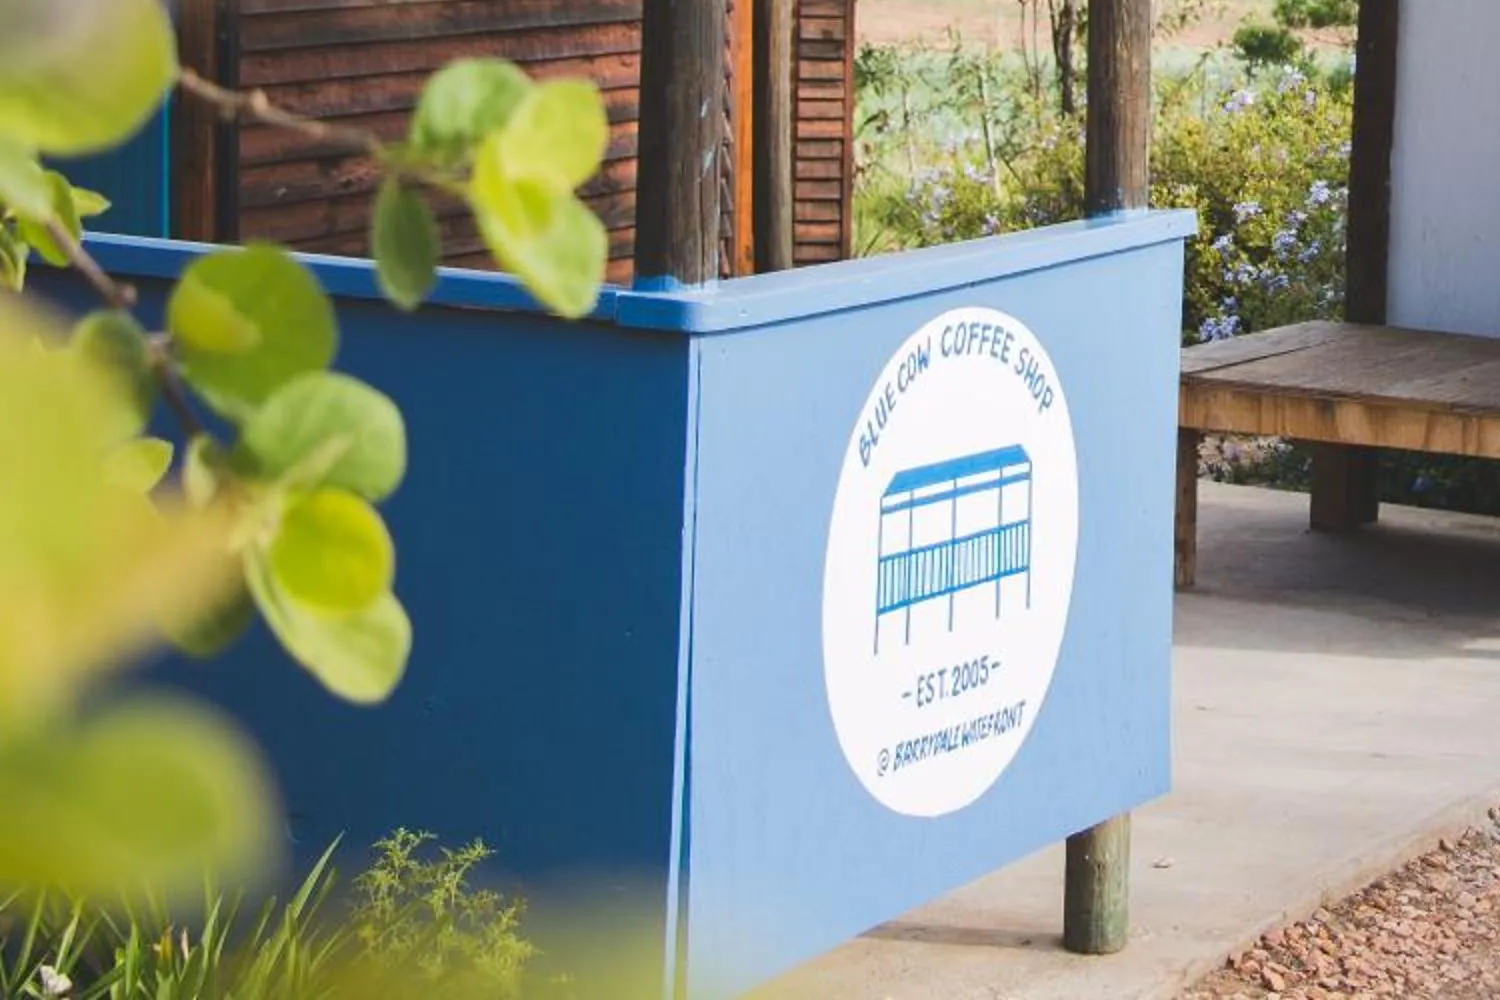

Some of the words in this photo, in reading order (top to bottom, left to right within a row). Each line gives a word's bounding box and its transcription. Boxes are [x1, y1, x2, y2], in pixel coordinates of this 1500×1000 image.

[858, 381, 897, 469] BLUE
[897, 335, 932, 394] COW
[940, 321, 1015, 364] COFFEE
[1013, 346, 1055, 414] SHOP
